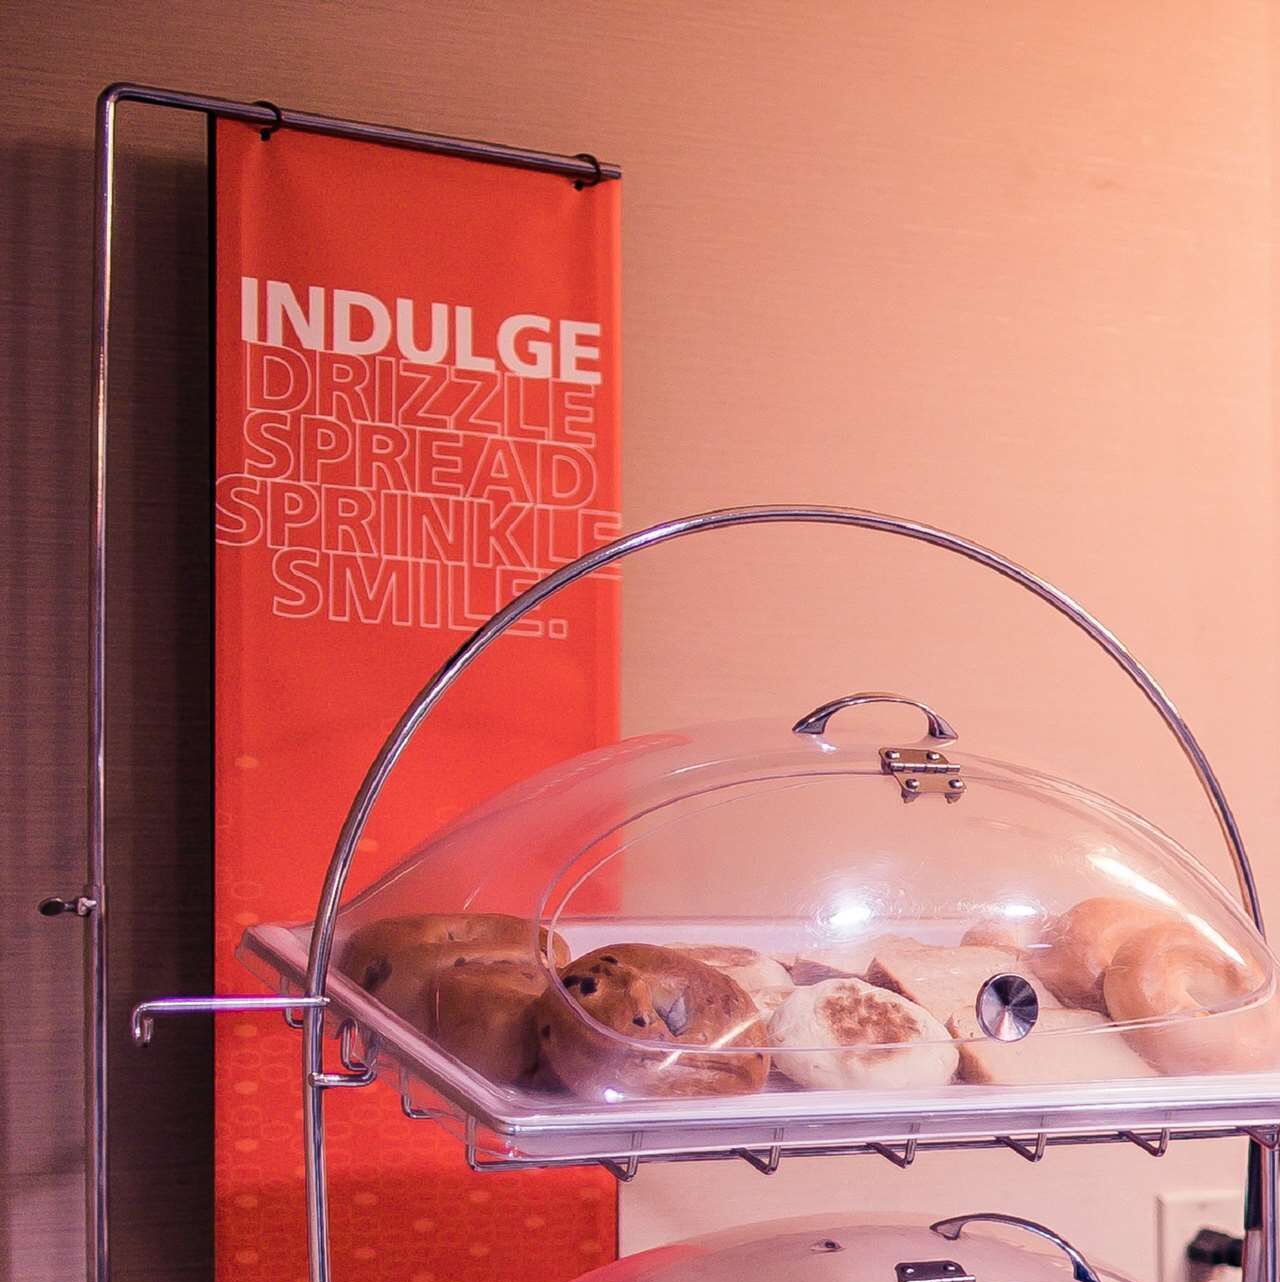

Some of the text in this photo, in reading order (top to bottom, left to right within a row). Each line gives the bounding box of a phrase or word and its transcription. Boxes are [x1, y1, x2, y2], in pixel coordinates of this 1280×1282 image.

[241, 277, 602, 385] INDULGE
[246, 341, 596, 448] DRIZZLE
[243, 410, 596, 509] SPREAD
